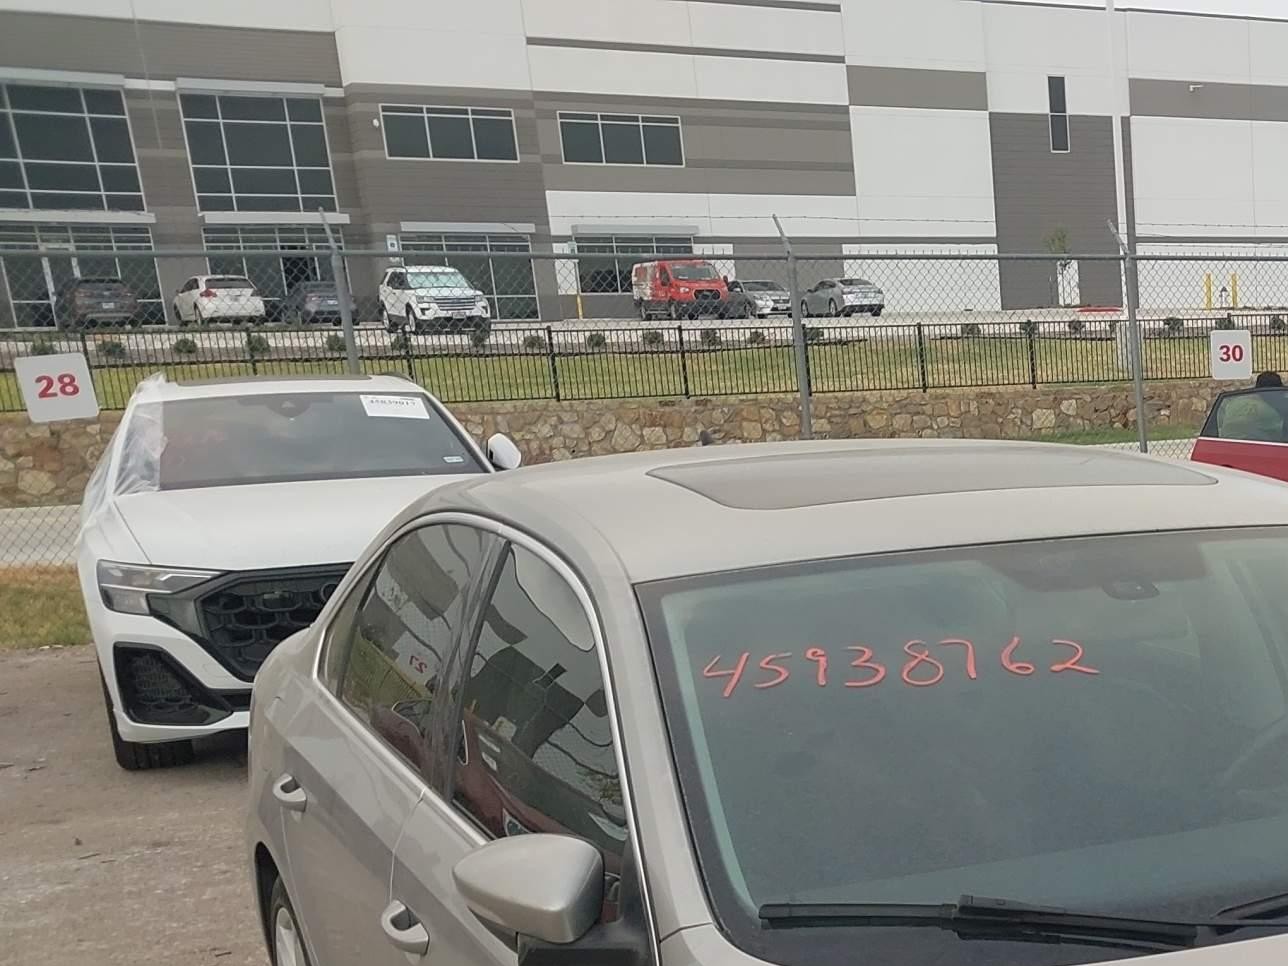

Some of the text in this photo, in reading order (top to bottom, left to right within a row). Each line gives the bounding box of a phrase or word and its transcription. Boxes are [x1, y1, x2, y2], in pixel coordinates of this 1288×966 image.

[1219, 344, 1244, 362] 30
[35, 373, 80, 399] 28
[702, 636, 1101, 698] 45938762
